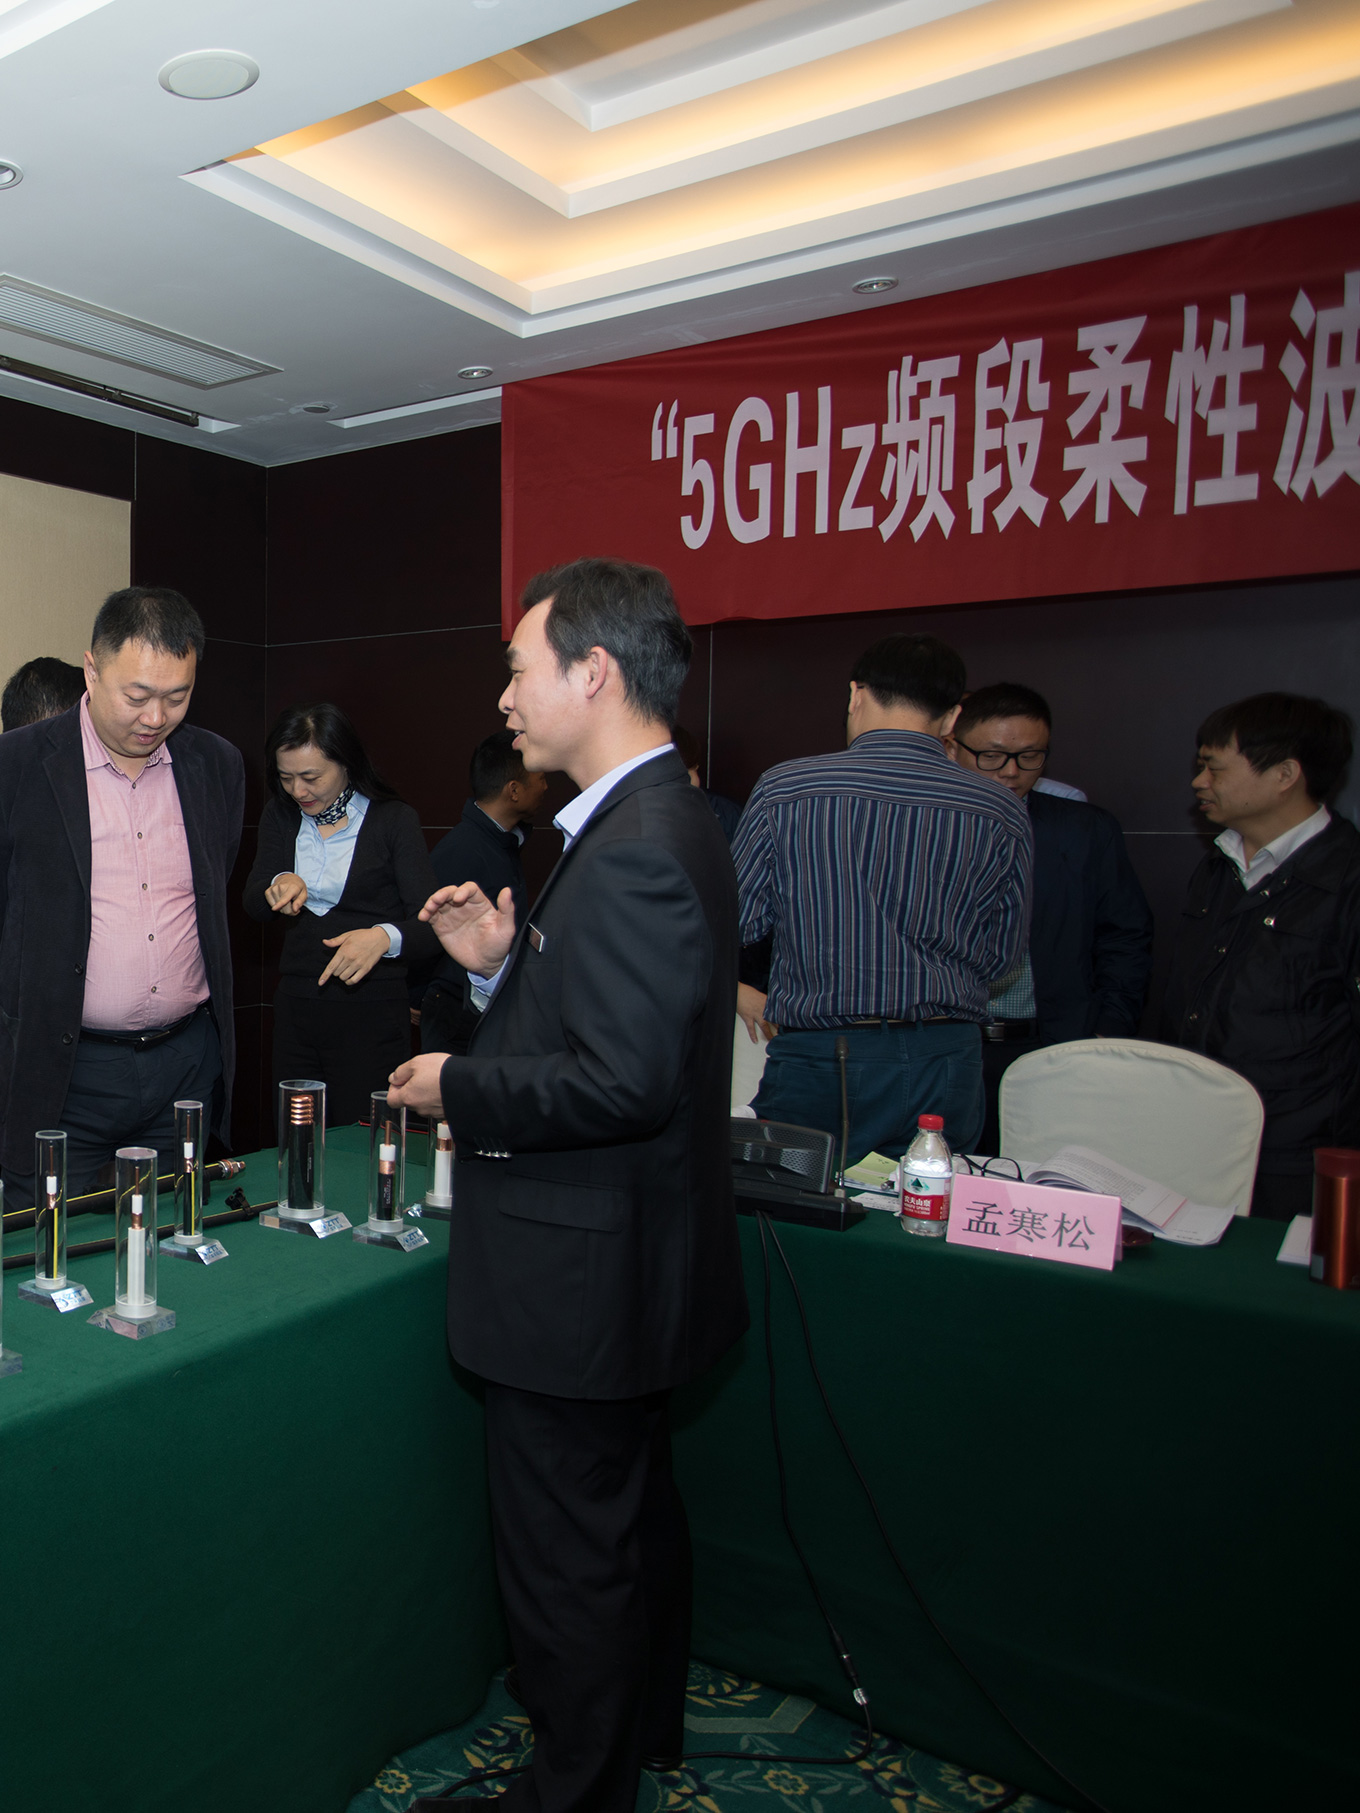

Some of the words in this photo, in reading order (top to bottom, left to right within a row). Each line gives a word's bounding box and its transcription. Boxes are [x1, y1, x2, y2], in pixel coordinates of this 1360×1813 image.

[326, 1217, 340, 1227] ZTT
[962, 1200, 1095, 1250] 孟寒松
[407, 1230, 420, 1241] ZTT
